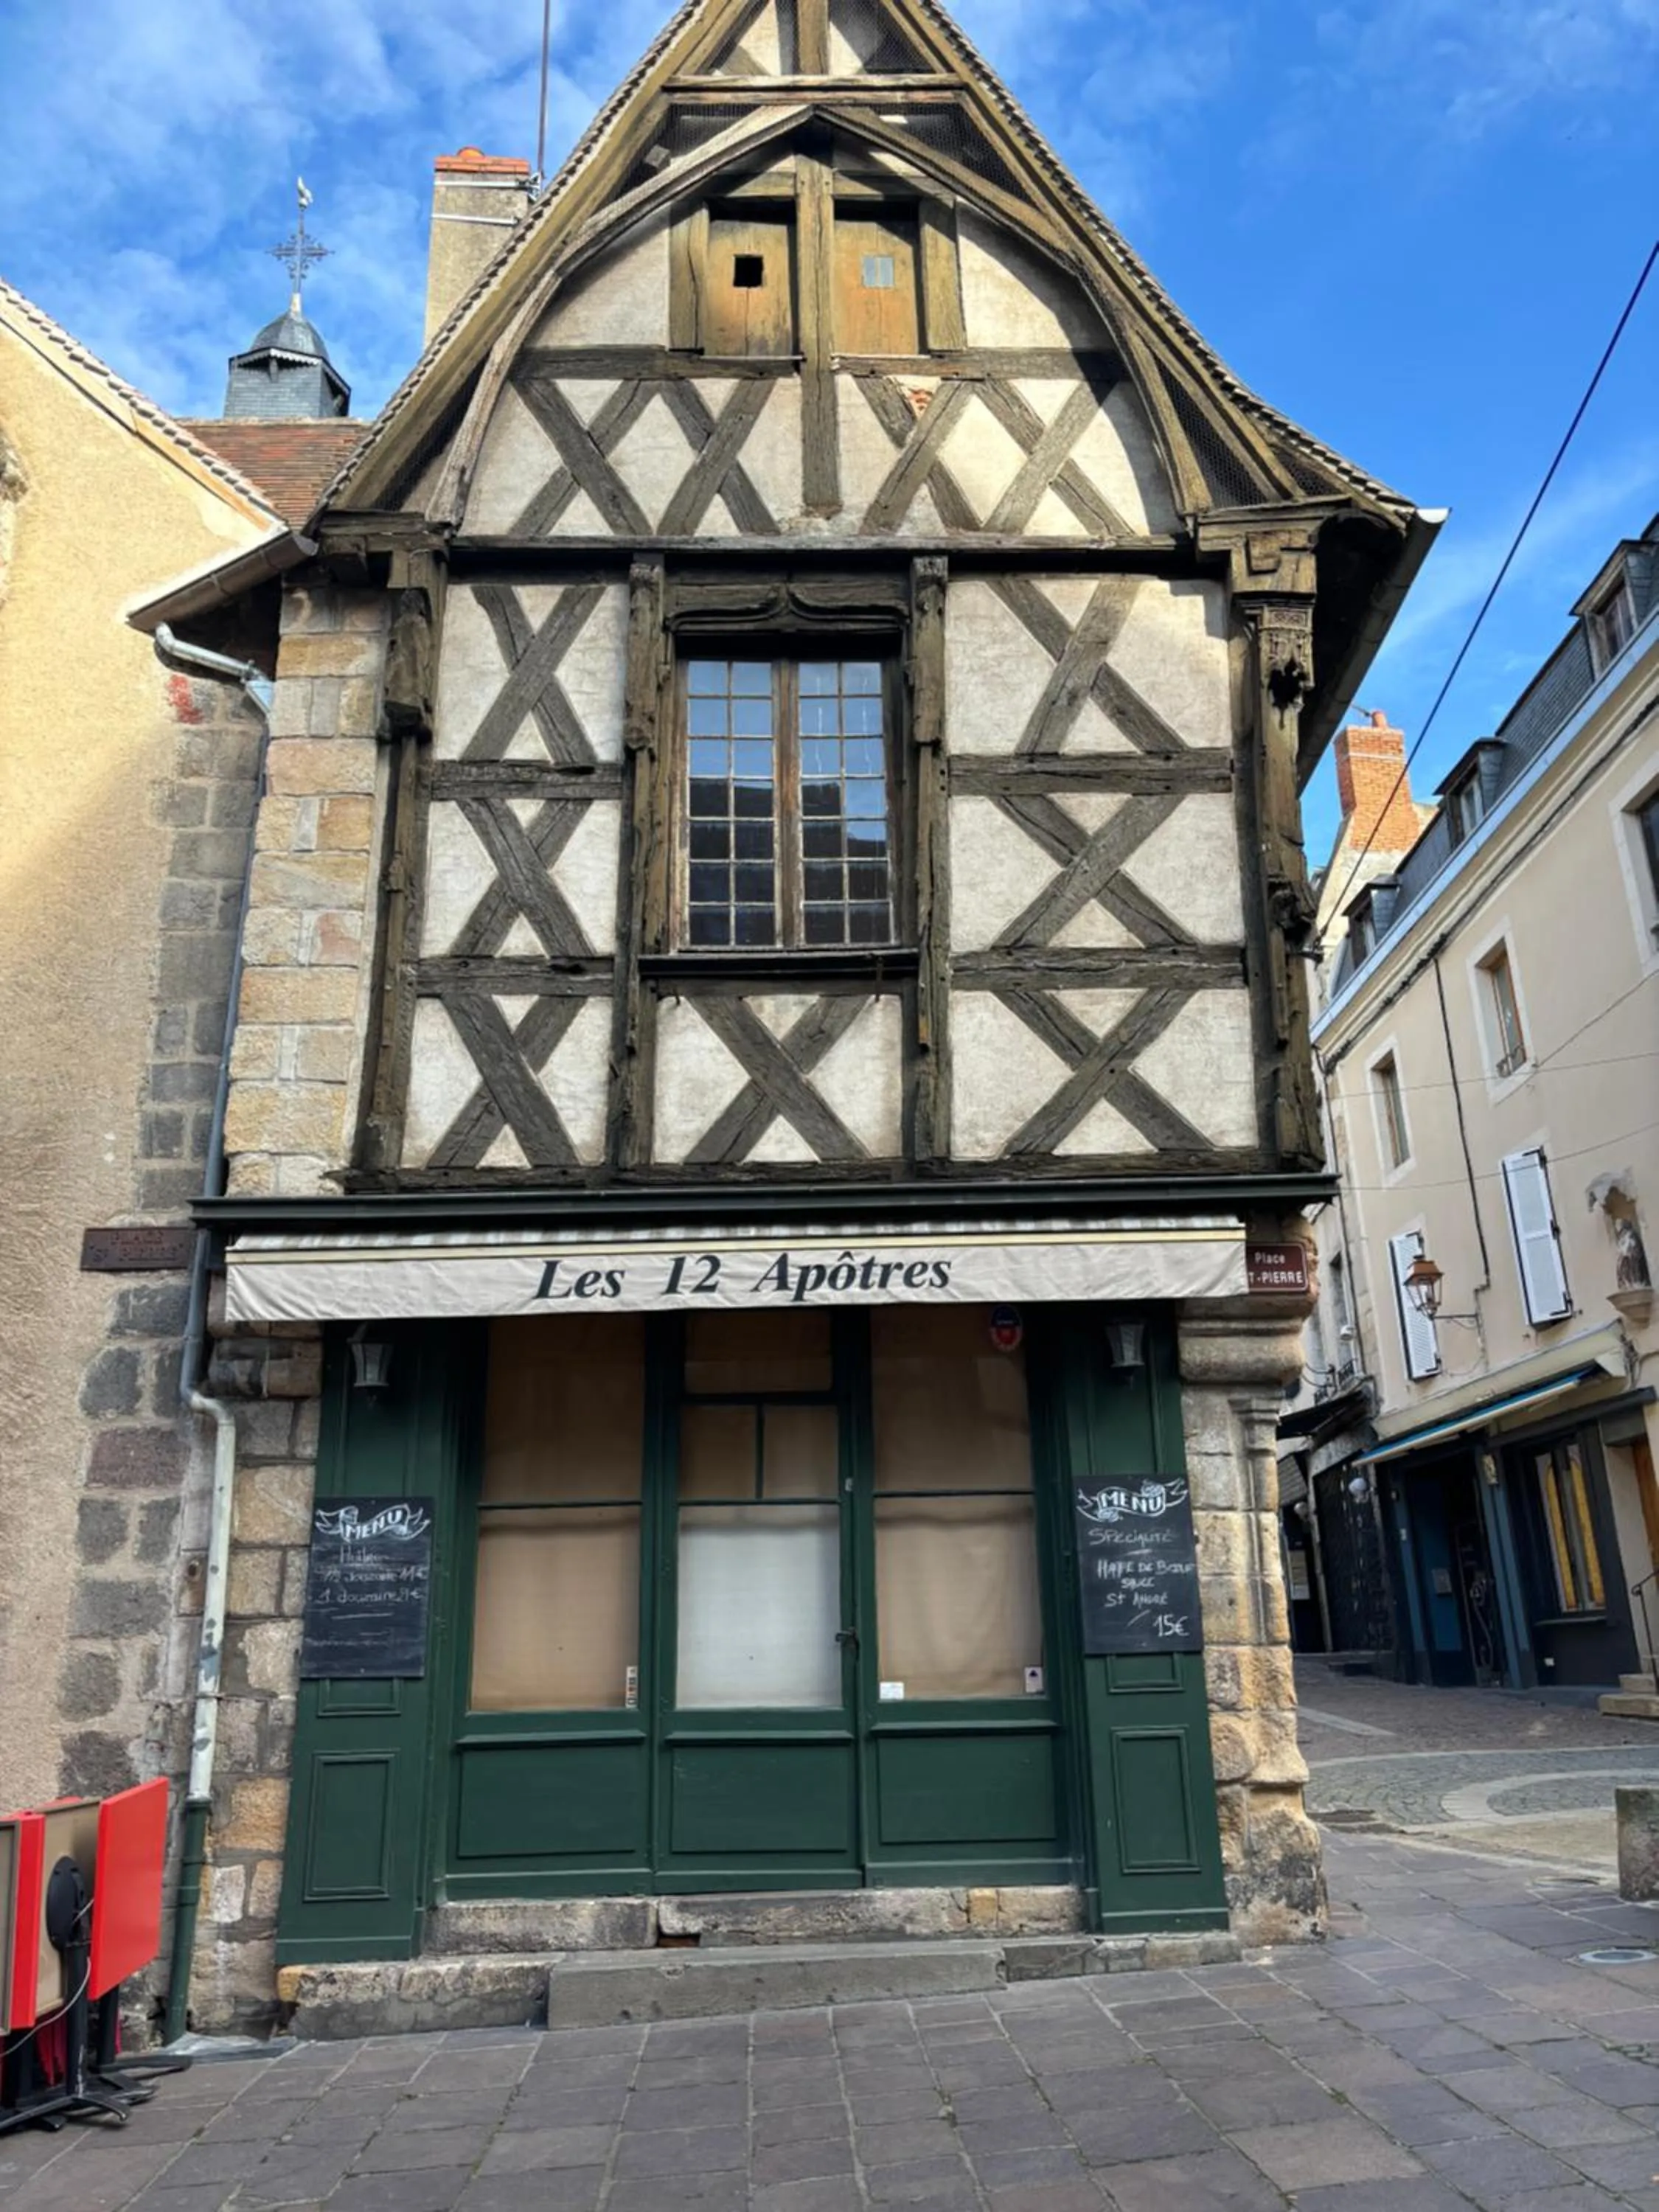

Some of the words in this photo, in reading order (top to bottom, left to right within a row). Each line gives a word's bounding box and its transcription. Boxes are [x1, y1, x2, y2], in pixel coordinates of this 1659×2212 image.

[532, 1259, 625, 1300] Les
[664, 1254, 723, 1295] 12
[750, 1251, 953, 1302] Apôtres
[1100, 1491, 1163, 1513] MENU
[345, 1509, 403, 1540] MENU
[1152, 1613, 1191, 1638] 15€
